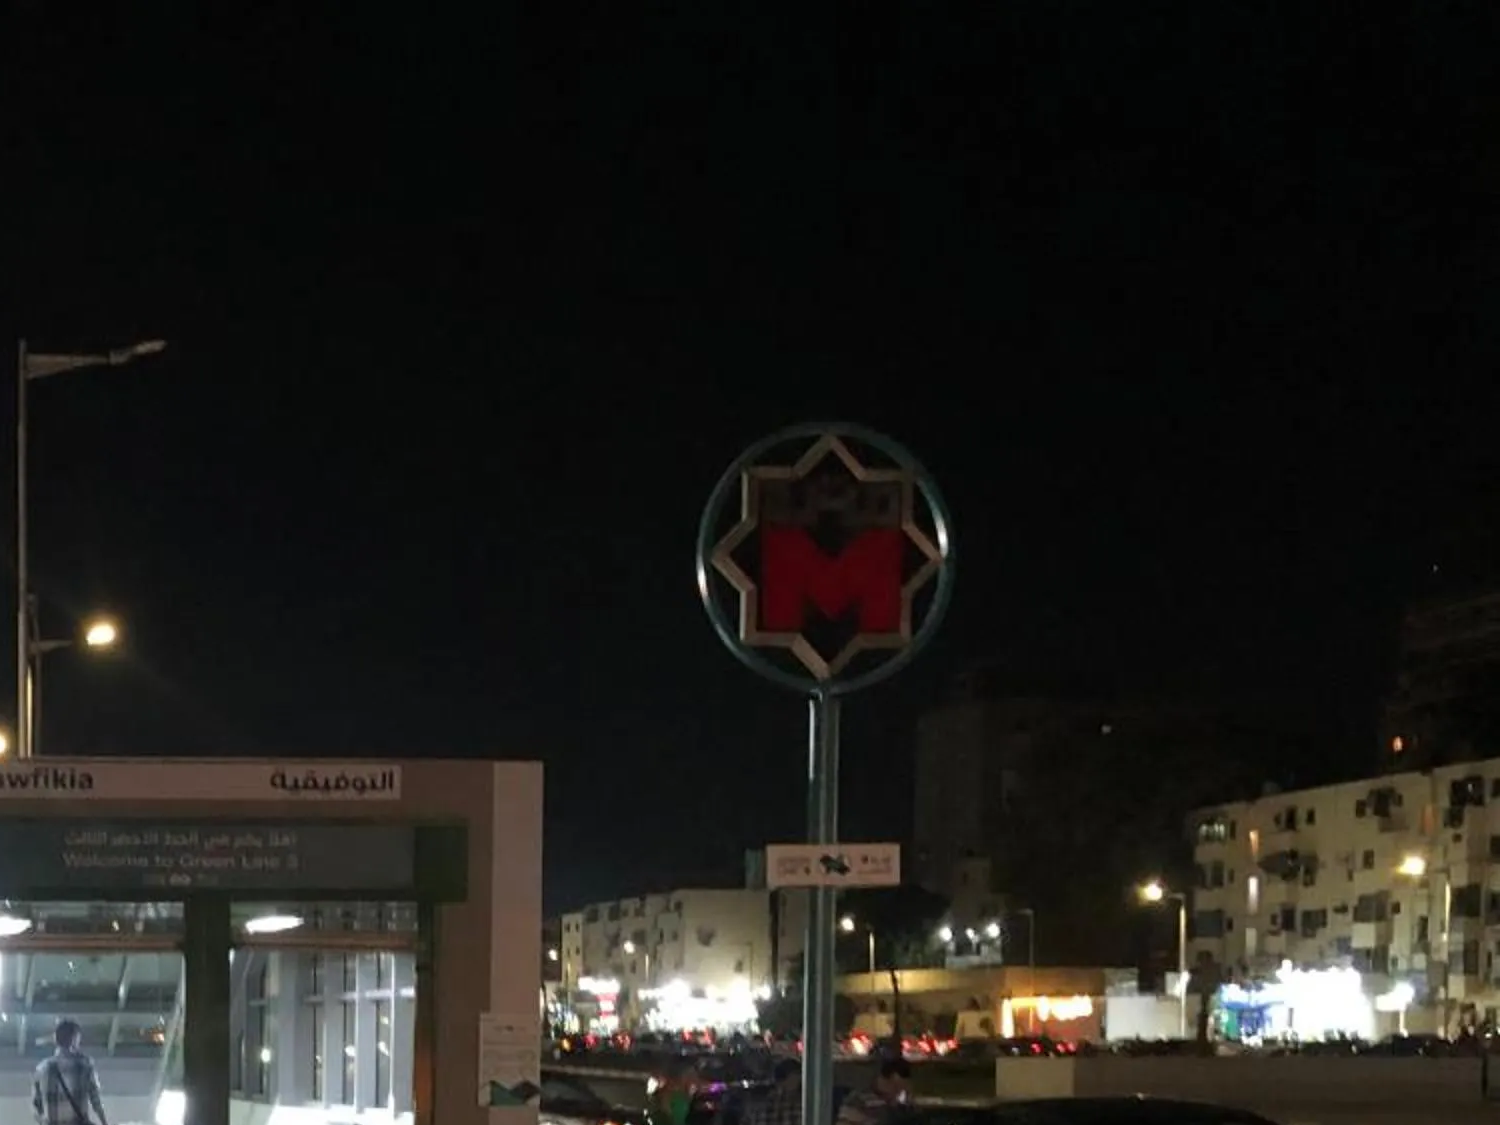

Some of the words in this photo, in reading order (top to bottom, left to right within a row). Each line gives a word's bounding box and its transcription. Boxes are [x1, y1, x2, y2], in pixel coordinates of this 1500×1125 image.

[62, 852, 149, 869] Welcome
[154, 853, 174, 868] to
[180, 852, 236, 869] Green
